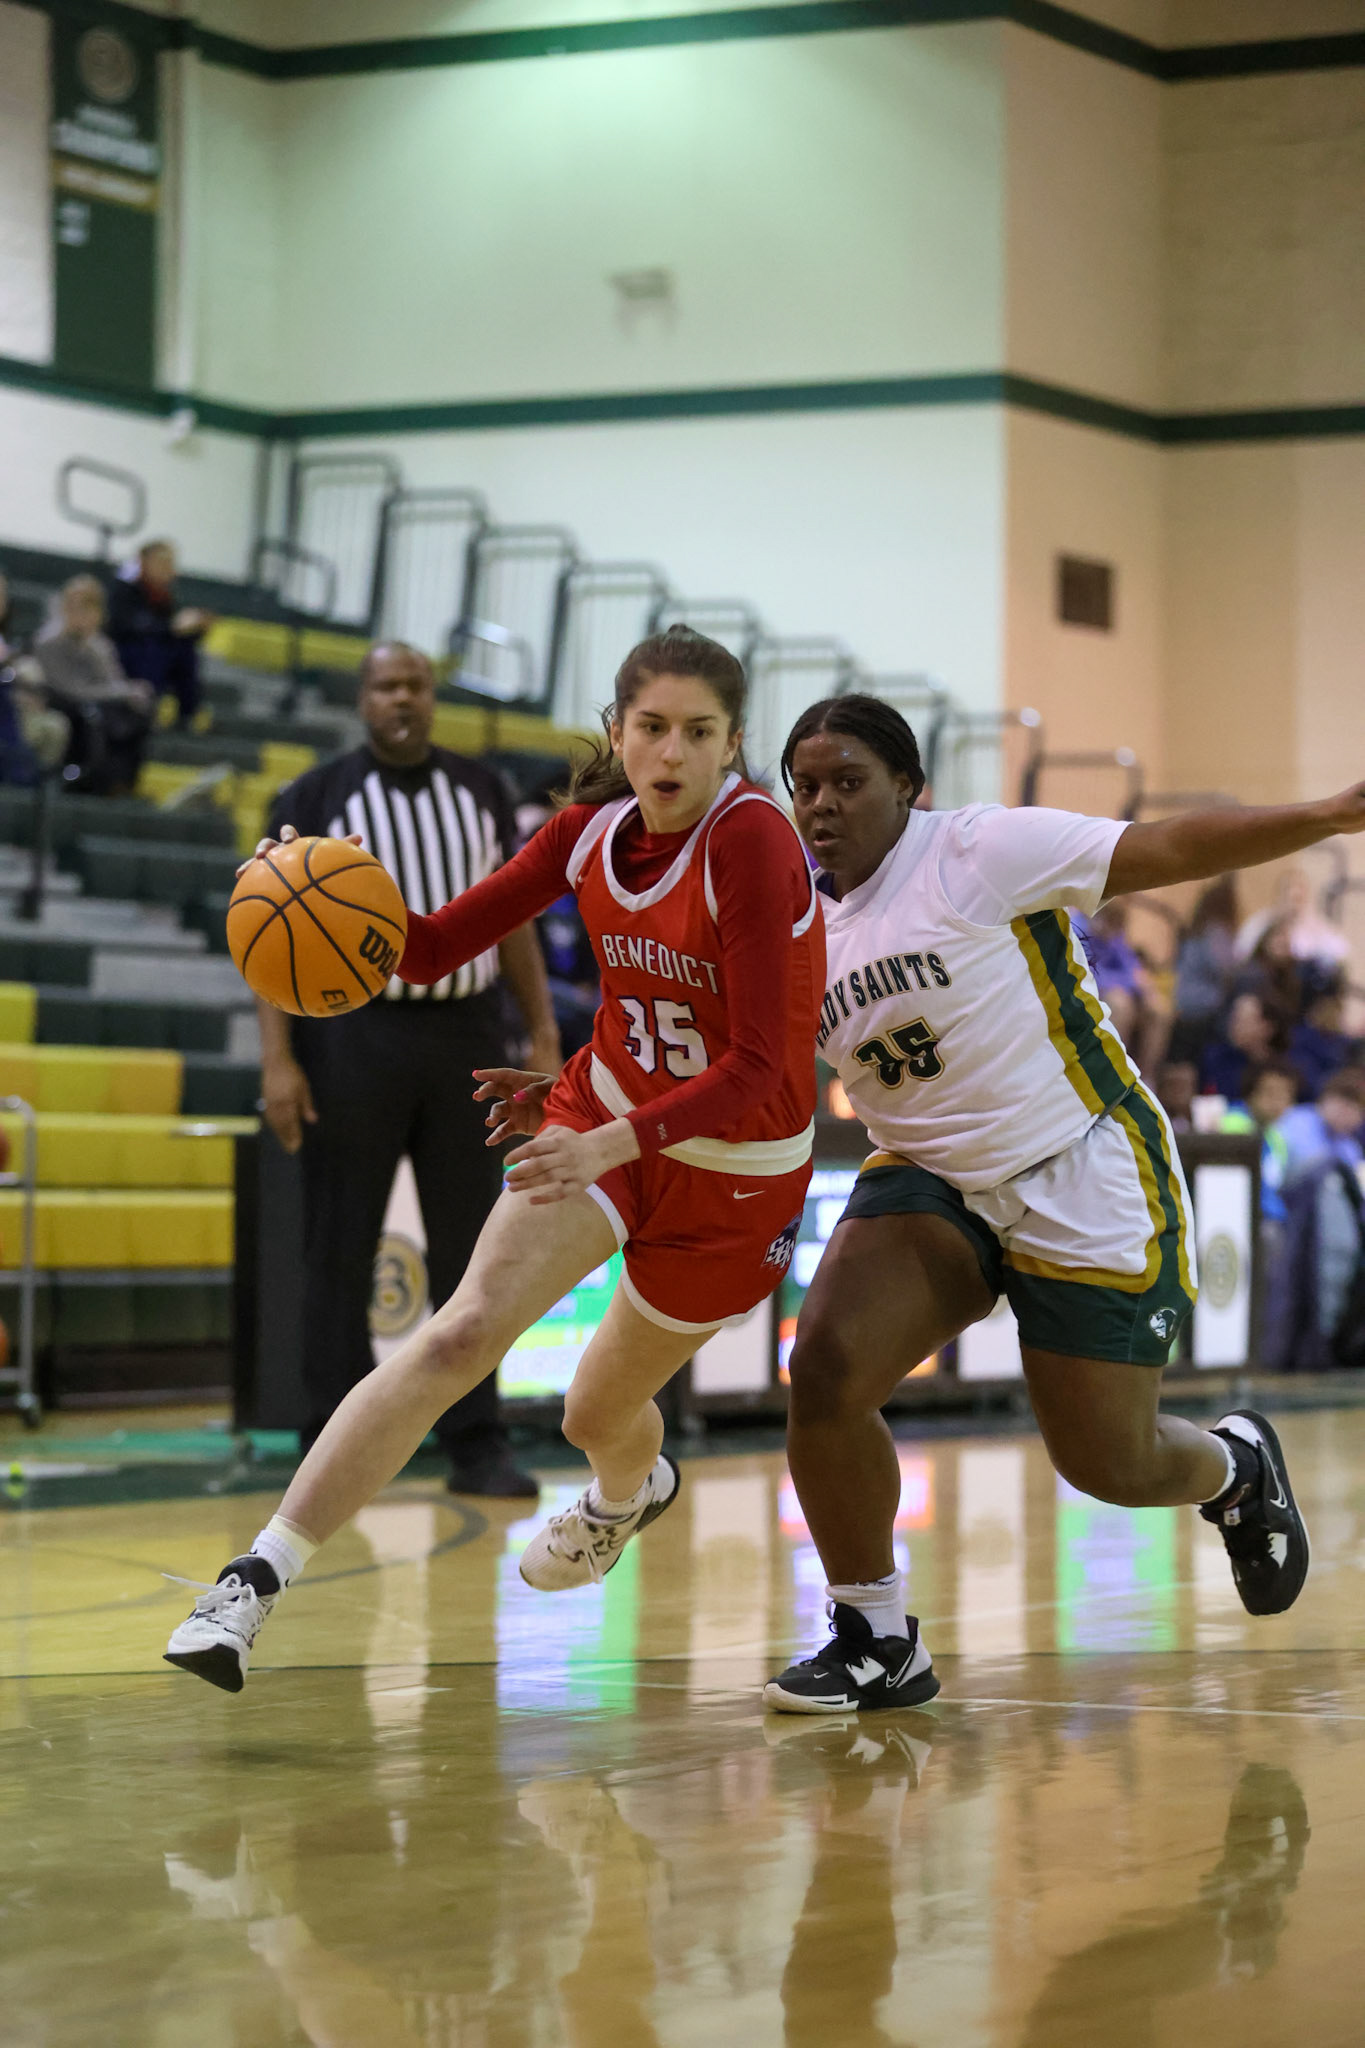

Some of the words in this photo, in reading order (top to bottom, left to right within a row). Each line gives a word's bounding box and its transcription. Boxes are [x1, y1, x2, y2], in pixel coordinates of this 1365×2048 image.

[600, 933, 719, 995] BENEDICT
[849, 950, 952, 1010] SAINTS
[616, 994, 711, 1080] 35
